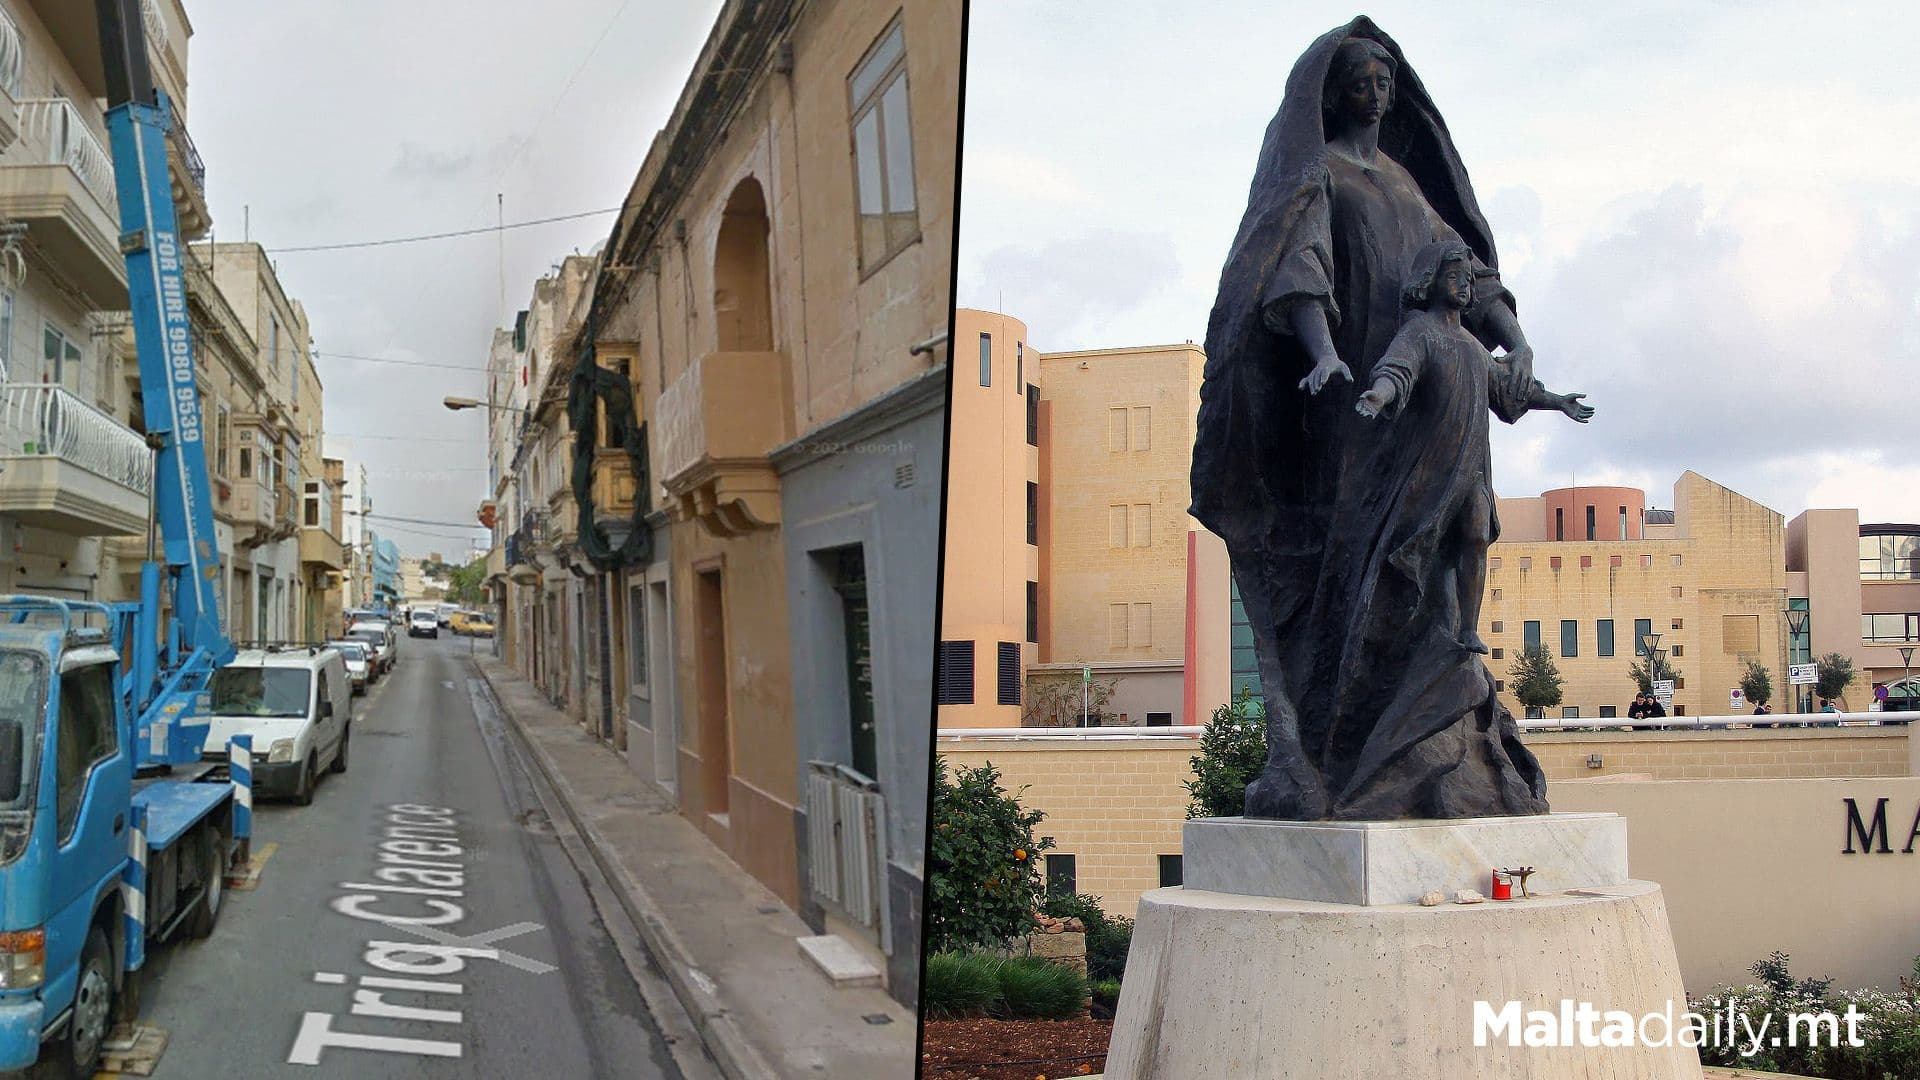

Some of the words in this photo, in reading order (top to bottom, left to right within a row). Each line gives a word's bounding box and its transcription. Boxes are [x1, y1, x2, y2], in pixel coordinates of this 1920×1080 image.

[156, 231, 177, 271] FOR
[162, 275, 185, 323] HIRE
[169, 327, 192, 383] 9980
[177, 387, 200, 442] 9539
